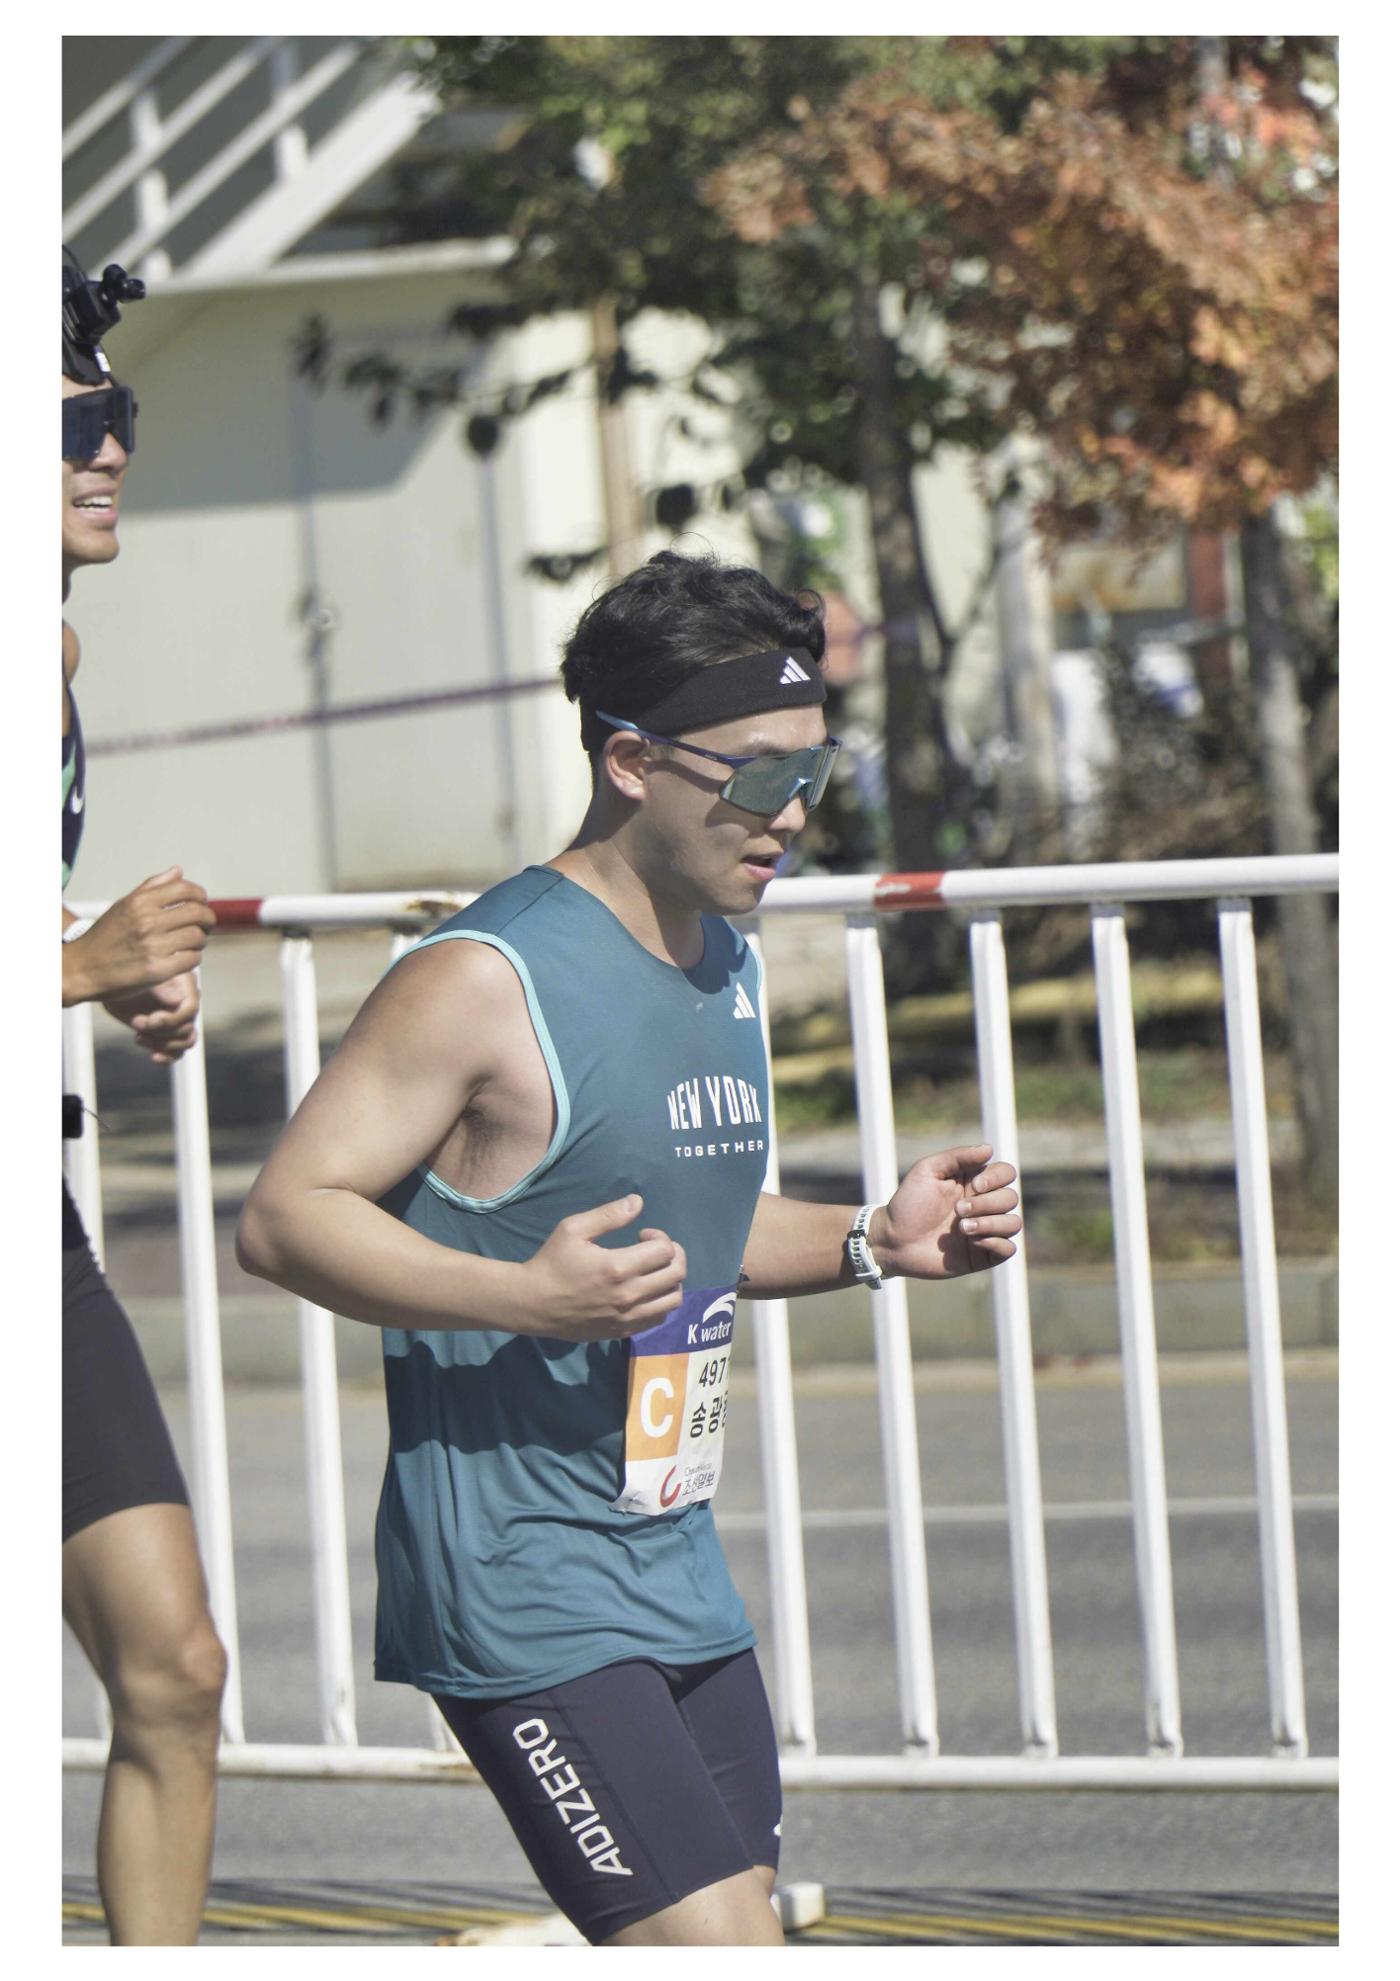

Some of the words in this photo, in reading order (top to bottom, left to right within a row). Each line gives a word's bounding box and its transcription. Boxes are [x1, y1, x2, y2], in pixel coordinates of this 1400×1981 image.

[667, 1079, 702, 1130] NEW
[705, 1075, 762, 1127] YORK
[675, 1140, 764, 1158] TOGETHER
[687, 1323, 697, 1345] K
[701, 1321, 731, 1342] water
[698, 1356, 731, 1388] 497
[640, 1377, 674, 1438] C
[512, 1718, 633, 1875] ADIZERO
